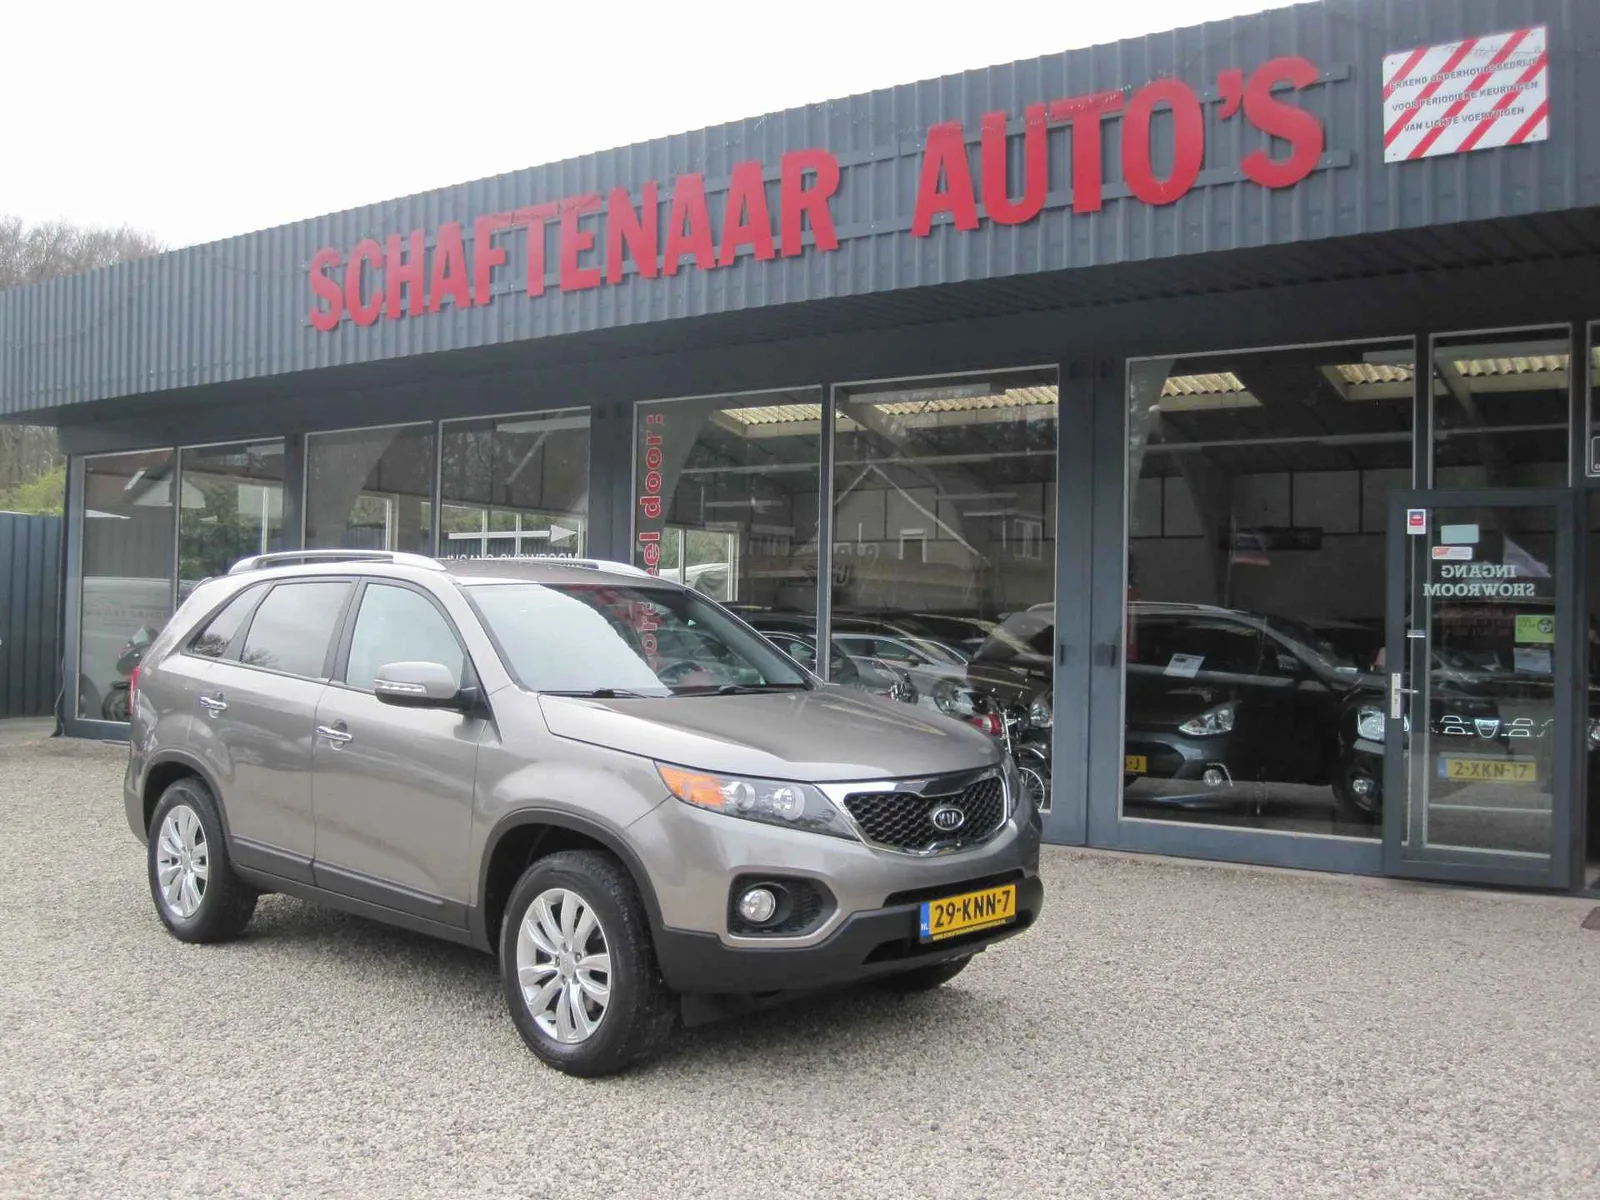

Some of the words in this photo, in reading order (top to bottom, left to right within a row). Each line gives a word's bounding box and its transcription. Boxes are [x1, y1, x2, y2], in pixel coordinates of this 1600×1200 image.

[1392, 101, 1417, 112] VOOR
[1419, 90, 1478, 107] PERIODIEKE
[1479, 80, 1538, 97] KEURINGEN
[1404, 121, 1423, 132] VAN
[1425, 116, 1459, 129] LICHTE
[1462, 106, 1525, 122] VOERTUIGEN
[309, 148, 840, 332] SCHAFTENAAR
[911, 55, 1324, 237] AUTO'S
[934, 889, 1011, 929] 29-KNN-7
